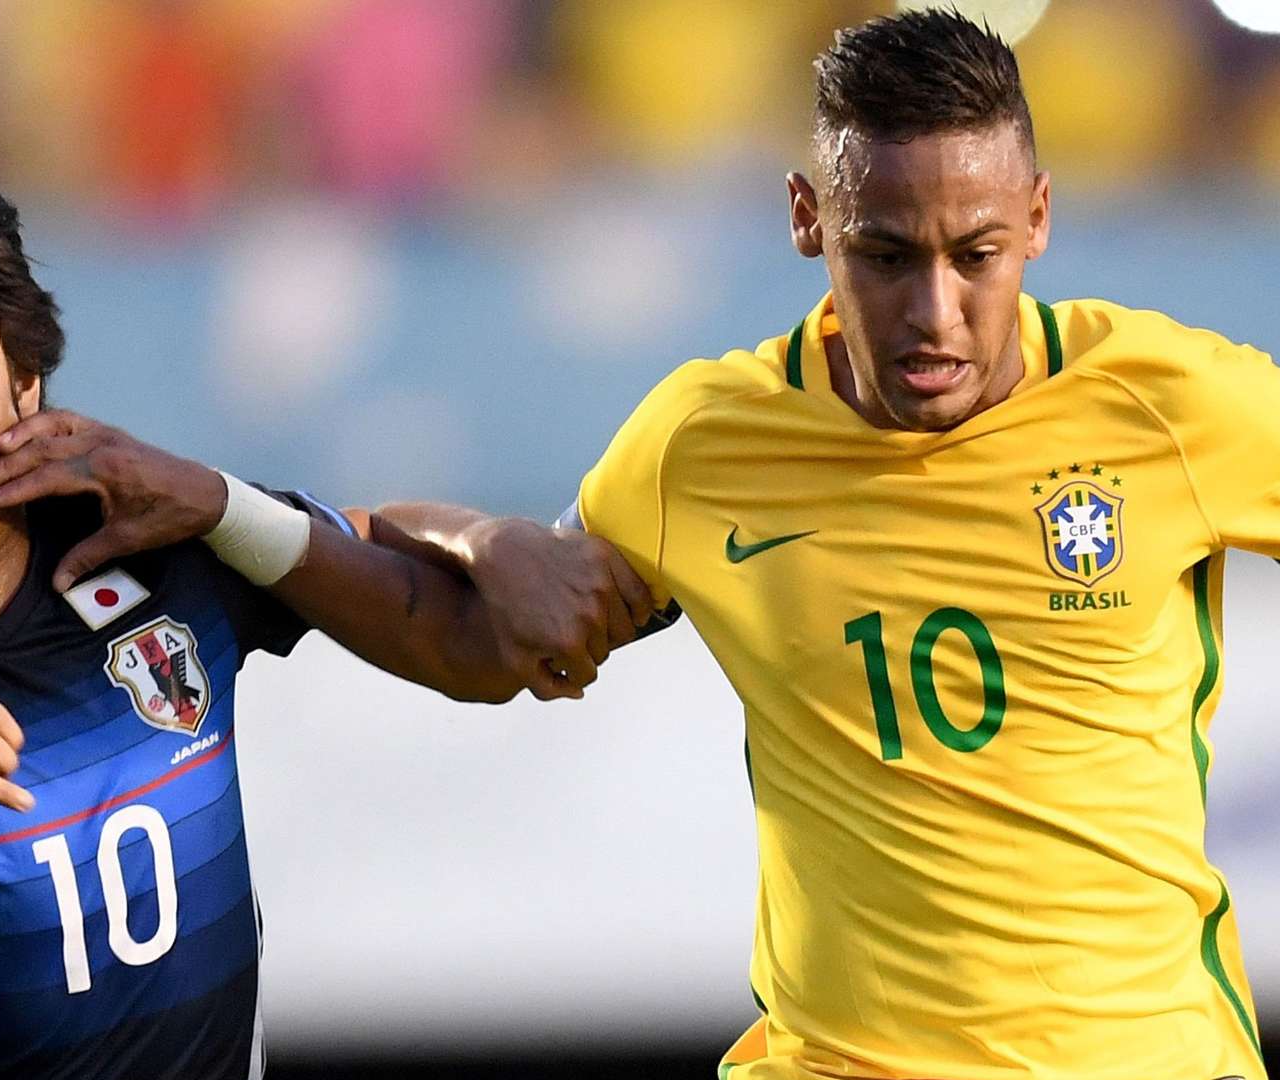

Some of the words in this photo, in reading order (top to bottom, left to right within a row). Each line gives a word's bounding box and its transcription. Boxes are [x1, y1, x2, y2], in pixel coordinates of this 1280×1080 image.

[1069, 523, 1097, 537] CBF
[1048, 590, 1132, 612] BRASIL
[843, 606, 1007, 762] 10
[170, 730, 220, 765] JAPAN
[31, 804, 178, 994] 10
